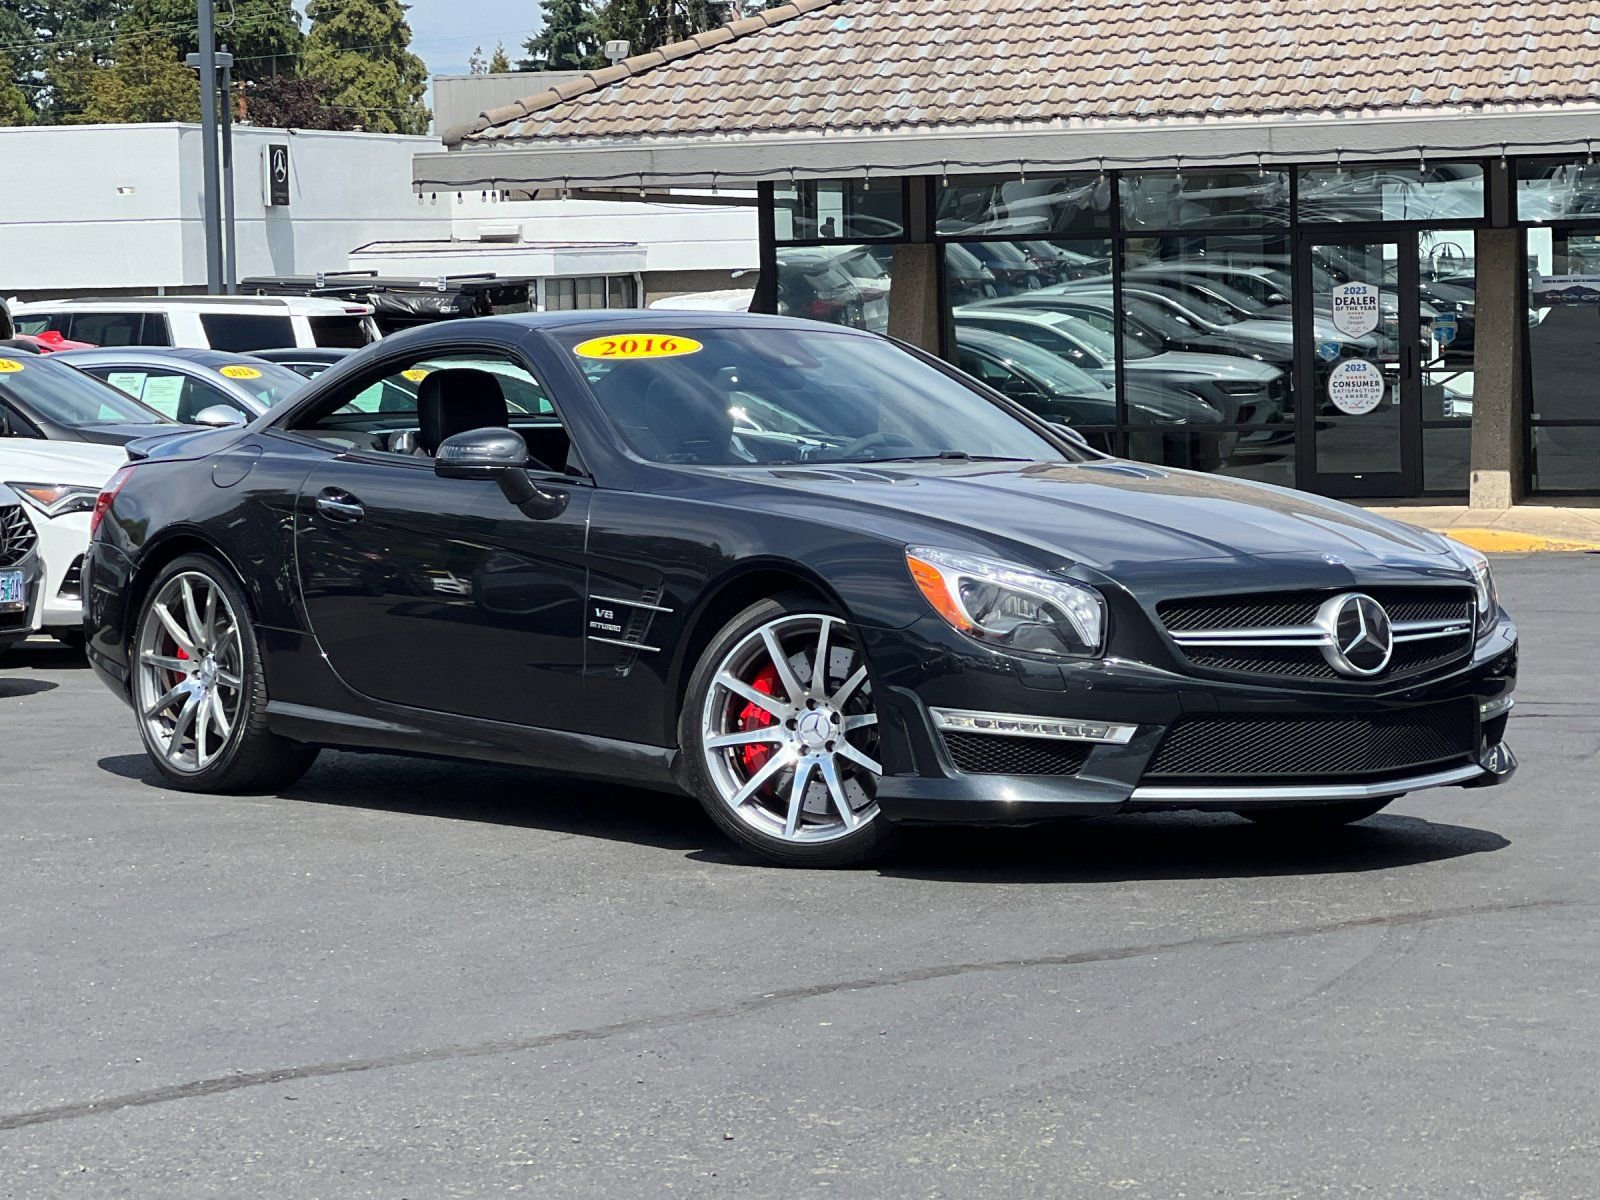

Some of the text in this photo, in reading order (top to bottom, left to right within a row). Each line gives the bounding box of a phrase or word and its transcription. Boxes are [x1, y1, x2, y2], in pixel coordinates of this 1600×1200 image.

[1343, 286, 1368, 295] 2023
[1335, 296, 1376, 306] DEALER
[600, 338, 678, 356] 2016
[1345, 363, 1367, 372] 2023
[1332, 380, 1380, 388] CONSUMER
[594, 607, 613, 620] V8
